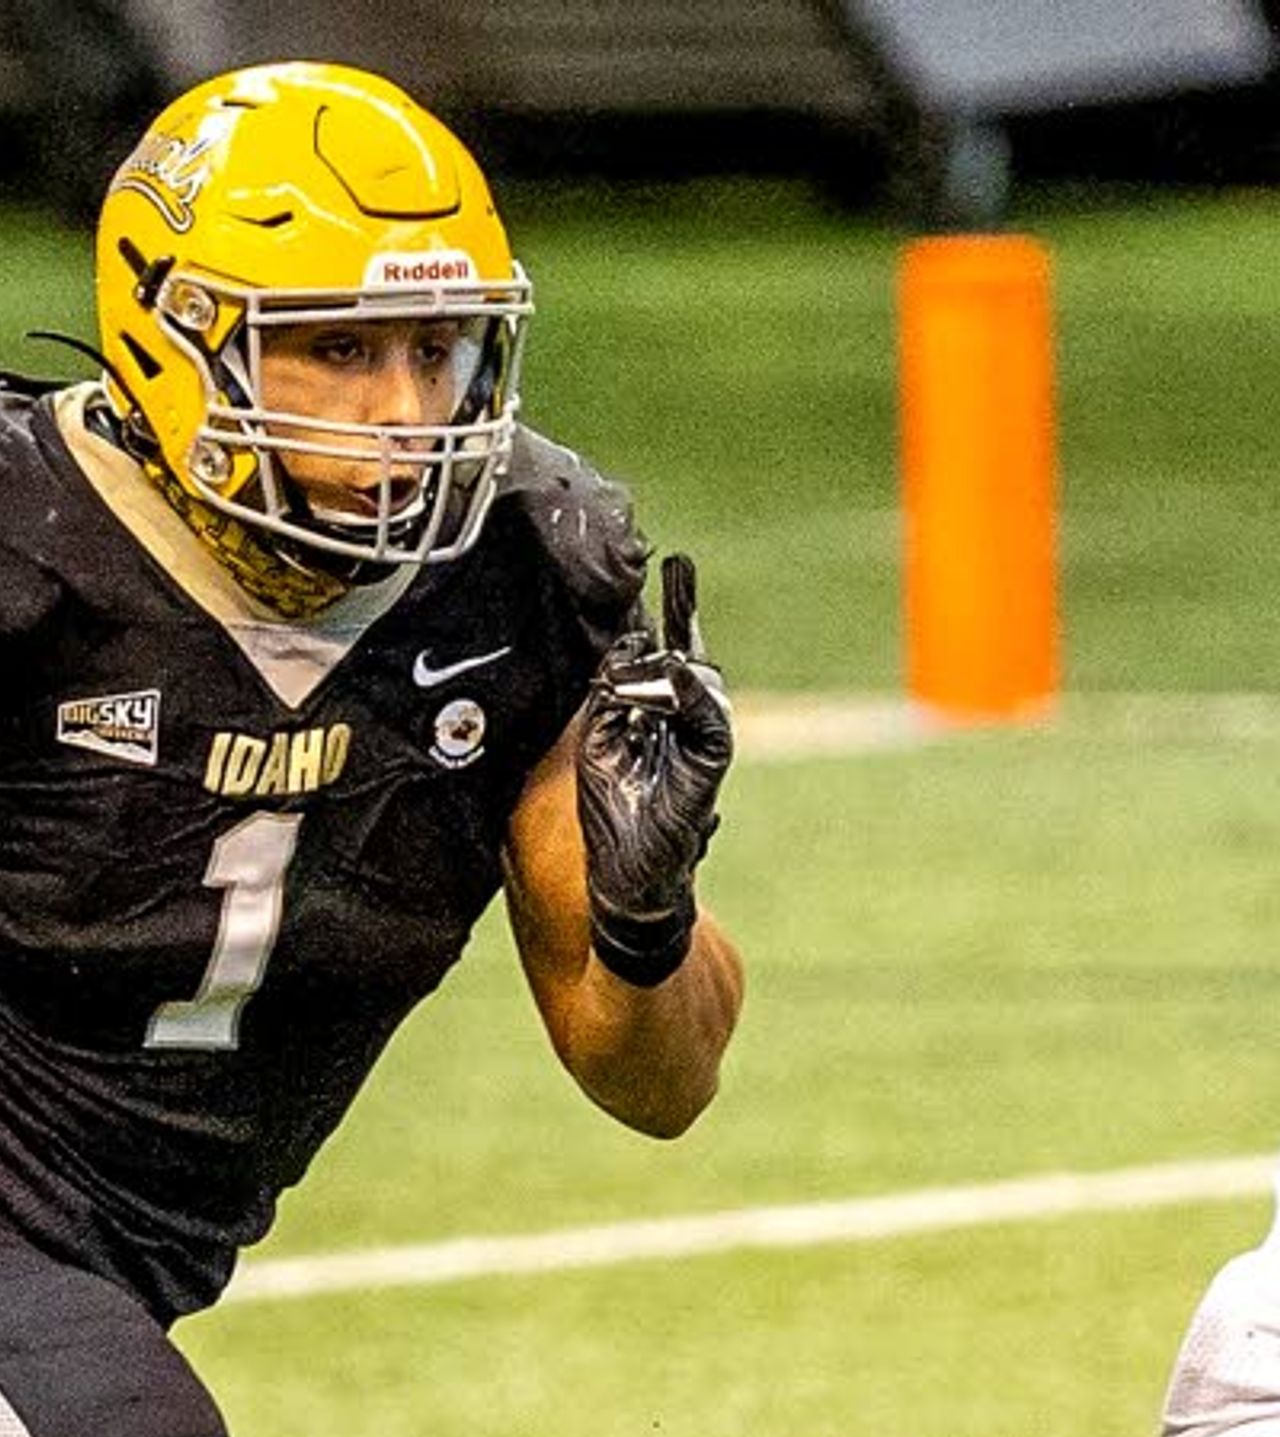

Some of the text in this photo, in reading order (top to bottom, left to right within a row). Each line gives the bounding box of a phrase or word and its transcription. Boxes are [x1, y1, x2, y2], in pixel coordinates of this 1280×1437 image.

[383, 260, 469, 282] Riddell
[203, 722, 352, 796] IDAHO
[142, 810, 305, 1052] 1
